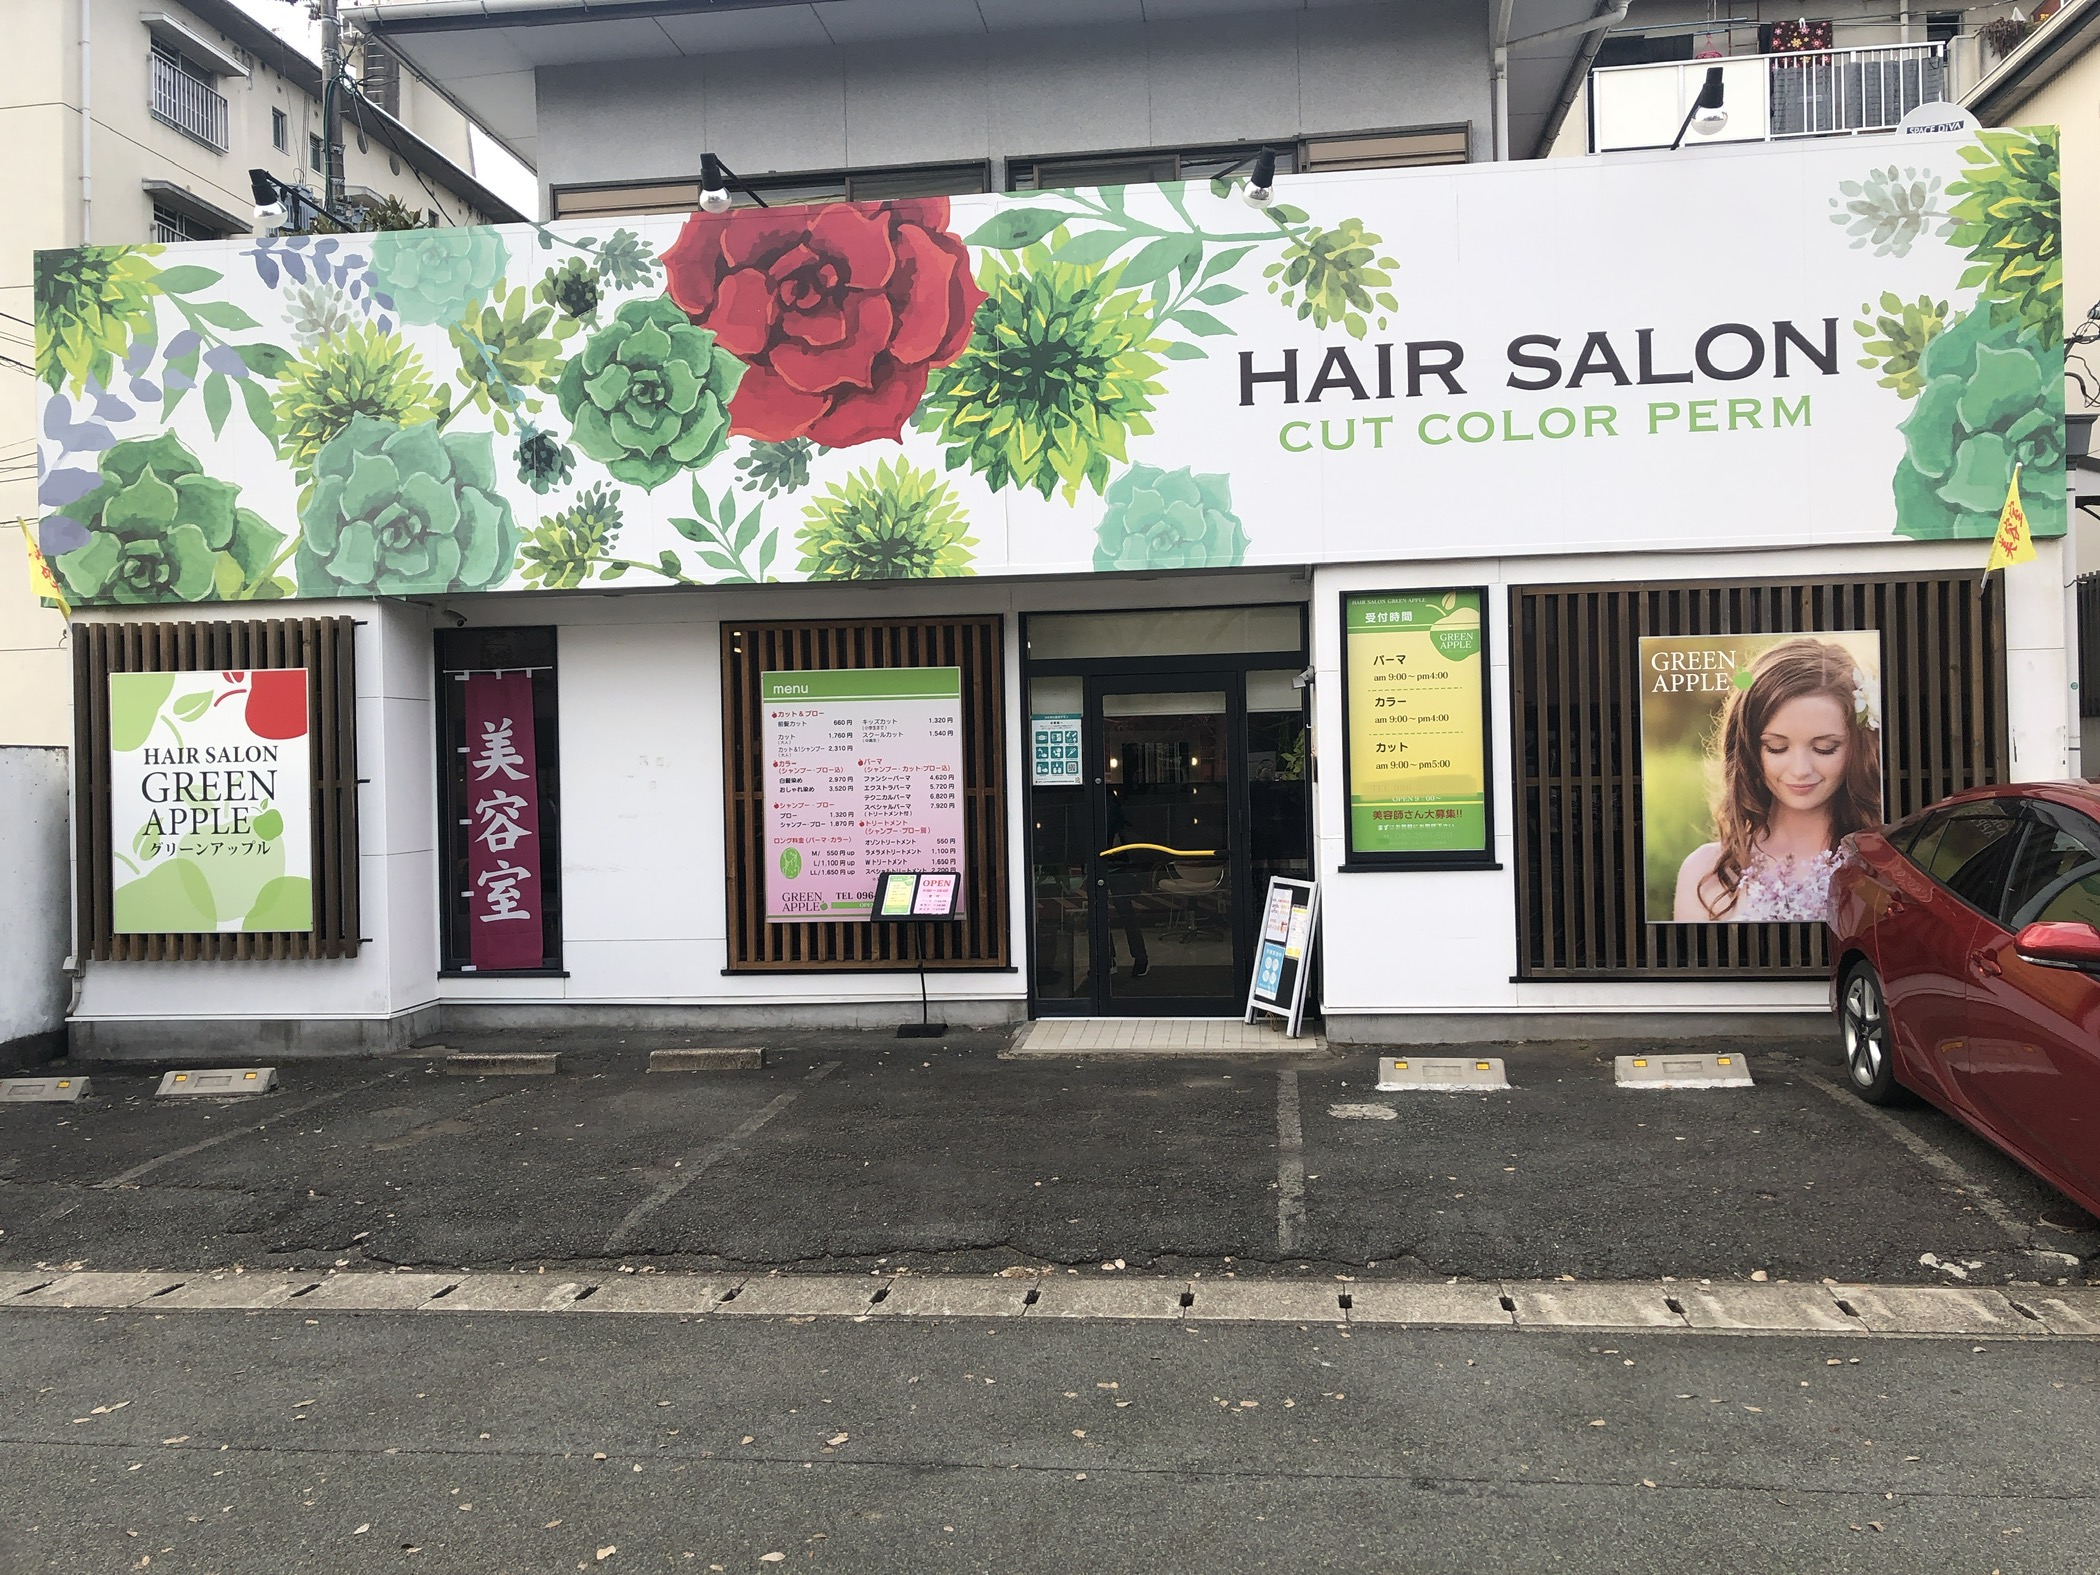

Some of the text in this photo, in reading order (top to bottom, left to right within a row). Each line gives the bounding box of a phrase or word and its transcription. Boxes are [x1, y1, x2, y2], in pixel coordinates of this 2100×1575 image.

[1238, 317, 1841, 406] HAIR SALON
[1279, 395, 1812, 452] CUT COLOR PERM
[1365, 611, 1413, 624] 受付時間
[1439, 632, 1474, 641] GREEN
[1440, 640, 1472, 650] APPLE
[1651, 650, 1737, 671] GREEN
[1652, 672, 1730, 693] APPLE
[773, 685, 809, 694] menu
[1374, 696, 1407, 708] カラー
[1374, 716, 1387, 724] am
[1376, 741, 1409, 753] カット
[144, 745, 278, 765] HAIR SALON
[141, 769, 278, 803] GREEN
[472, 717, 532, 923] 美容室
[1372, 809, 1463, 820] 美容師さん大募集!!
[142, 807, 251, 837] APPLE
[150, 841, 271, 857] グリーンアップル
[865, 848, 922, 856] ラメラメトリートメント
[922, 879, 952, 887] OPEN
[781, 892, 823, 902] GREEN
[835, 892, 854, 900] TEL
[782, 902, 820, 912] APPLE
